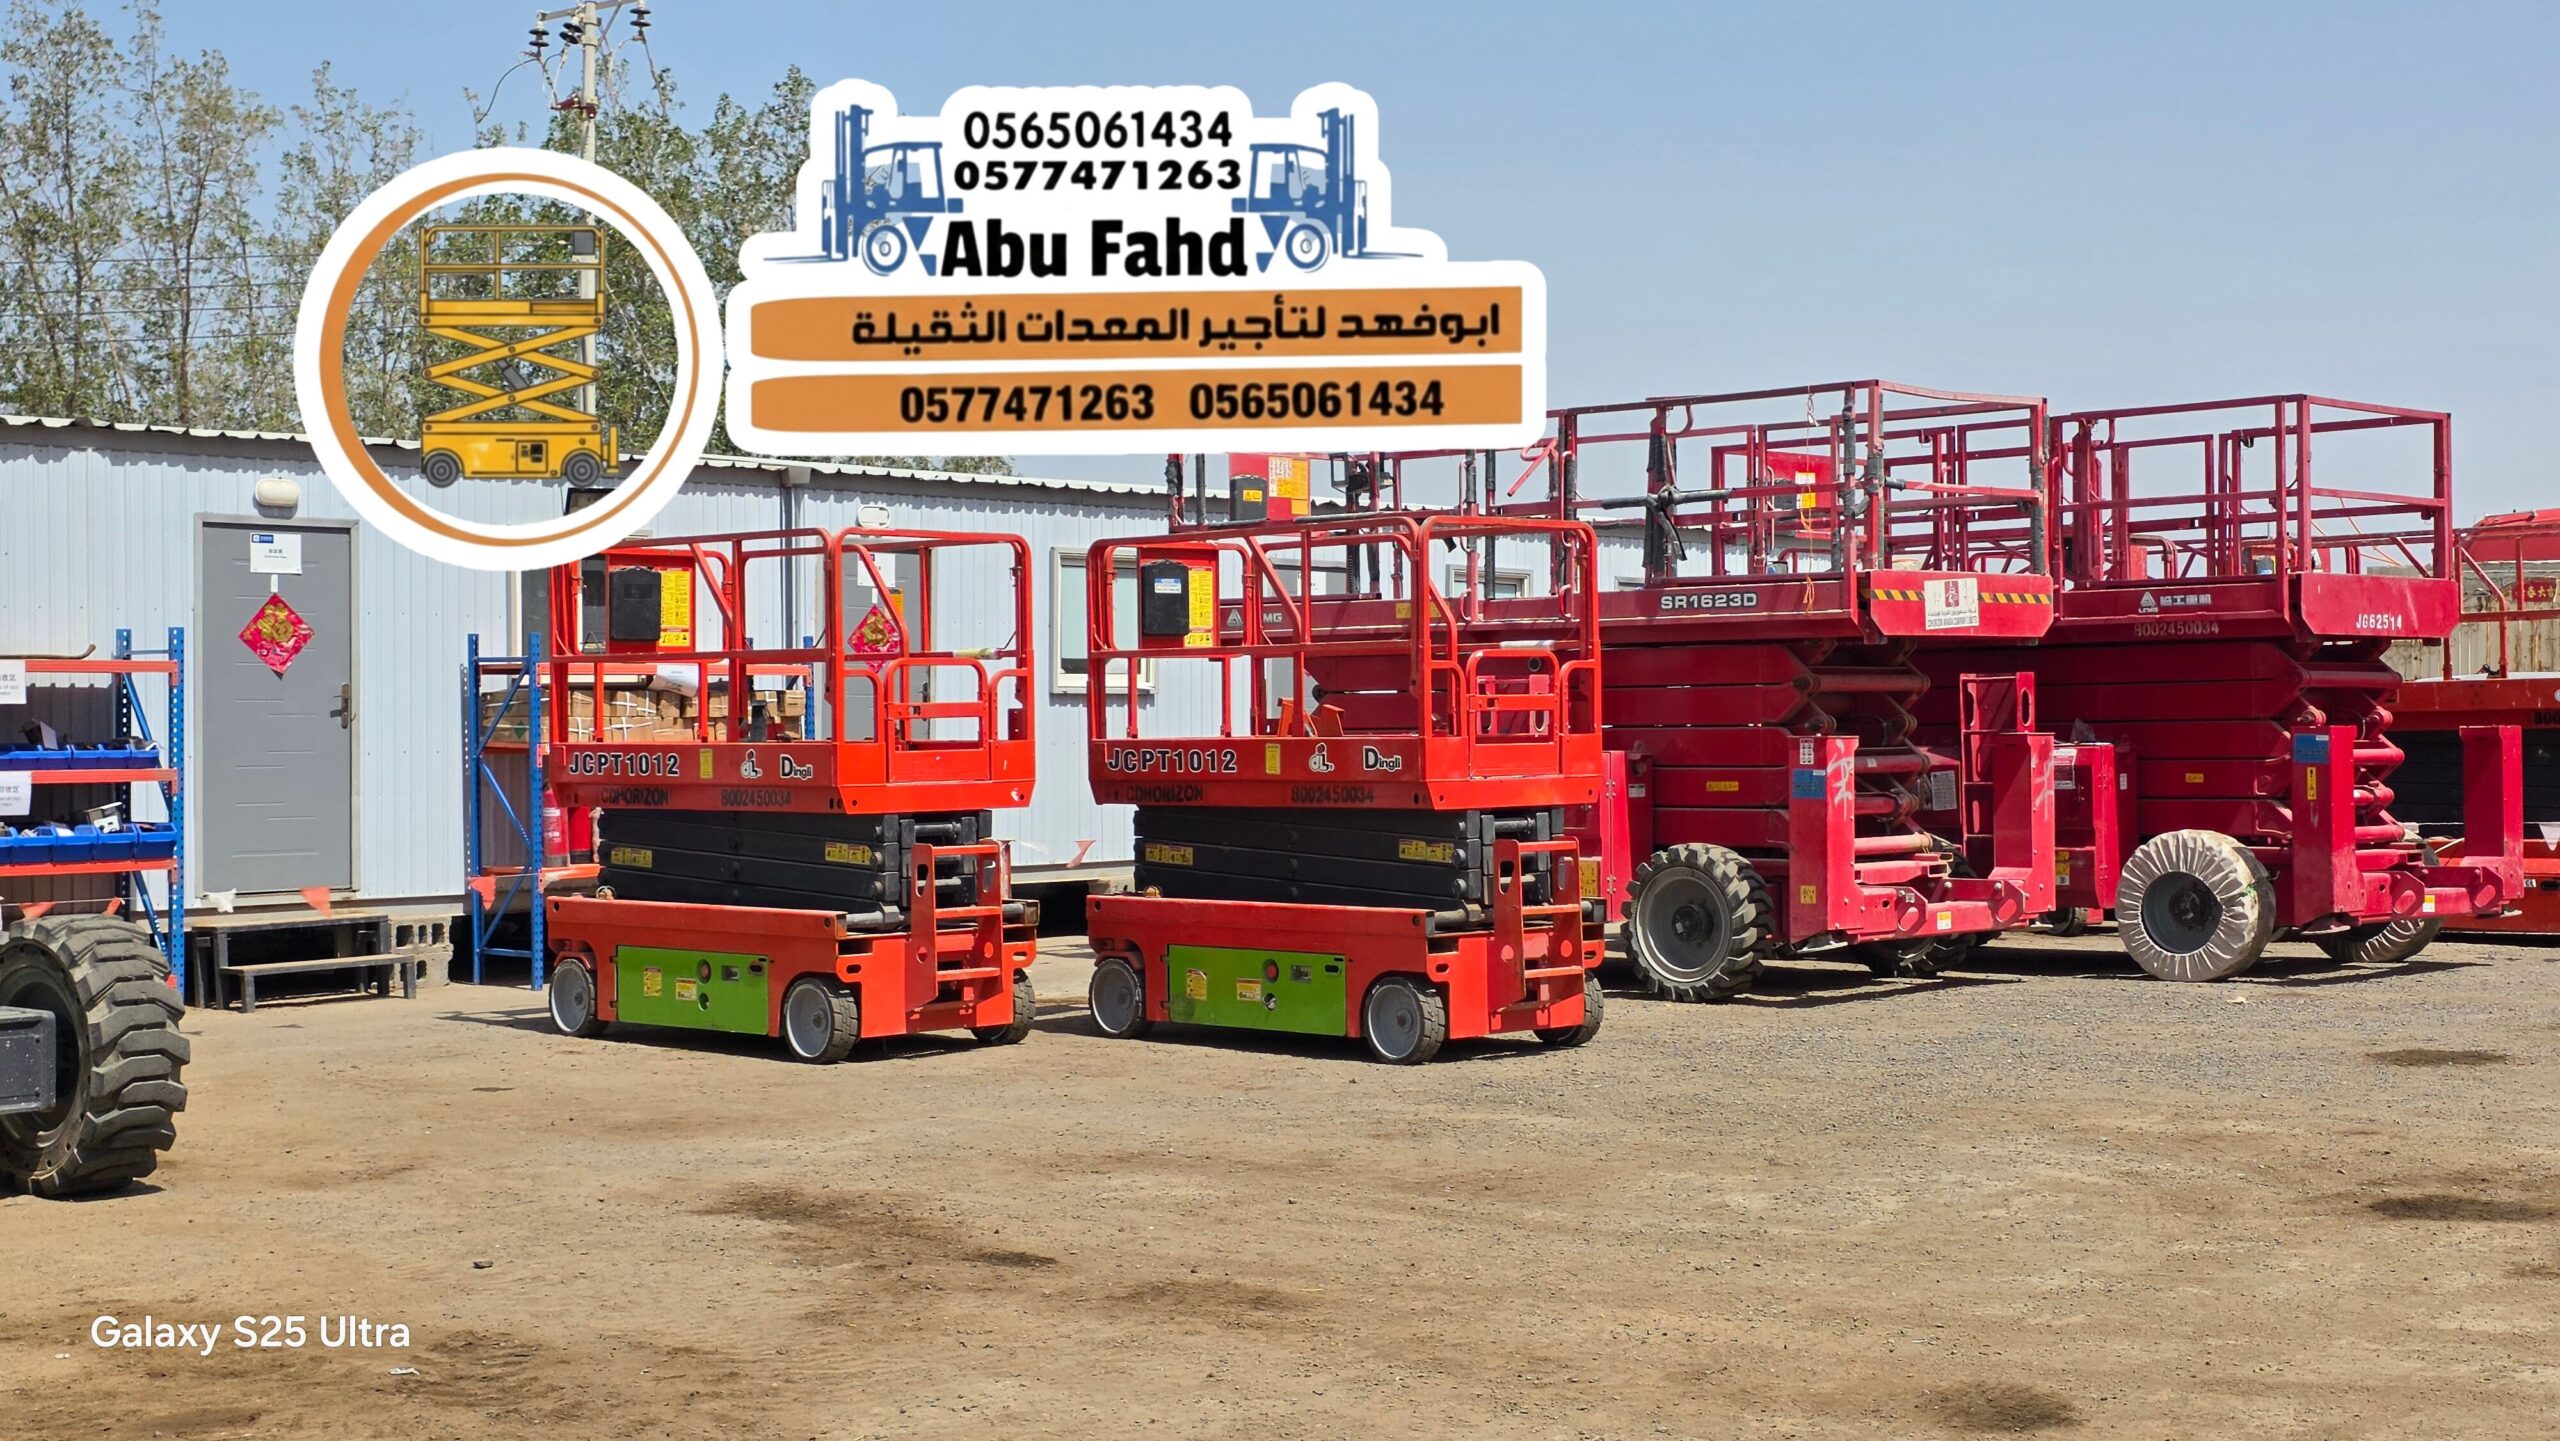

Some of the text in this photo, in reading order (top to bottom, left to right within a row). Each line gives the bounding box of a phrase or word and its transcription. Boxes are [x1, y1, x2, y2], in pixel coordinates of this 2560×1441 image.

[1660, 593, 1757, 609] SR1623D
[2356, 614, 2402, 630] JG62514
[569, 752, 680, 777] JCPT1012
[780, 754, 813, 780] Dingli
[1106, 748, 1238, 772] JCPT1012
[1362, 745, 1402, 771] Dingli
